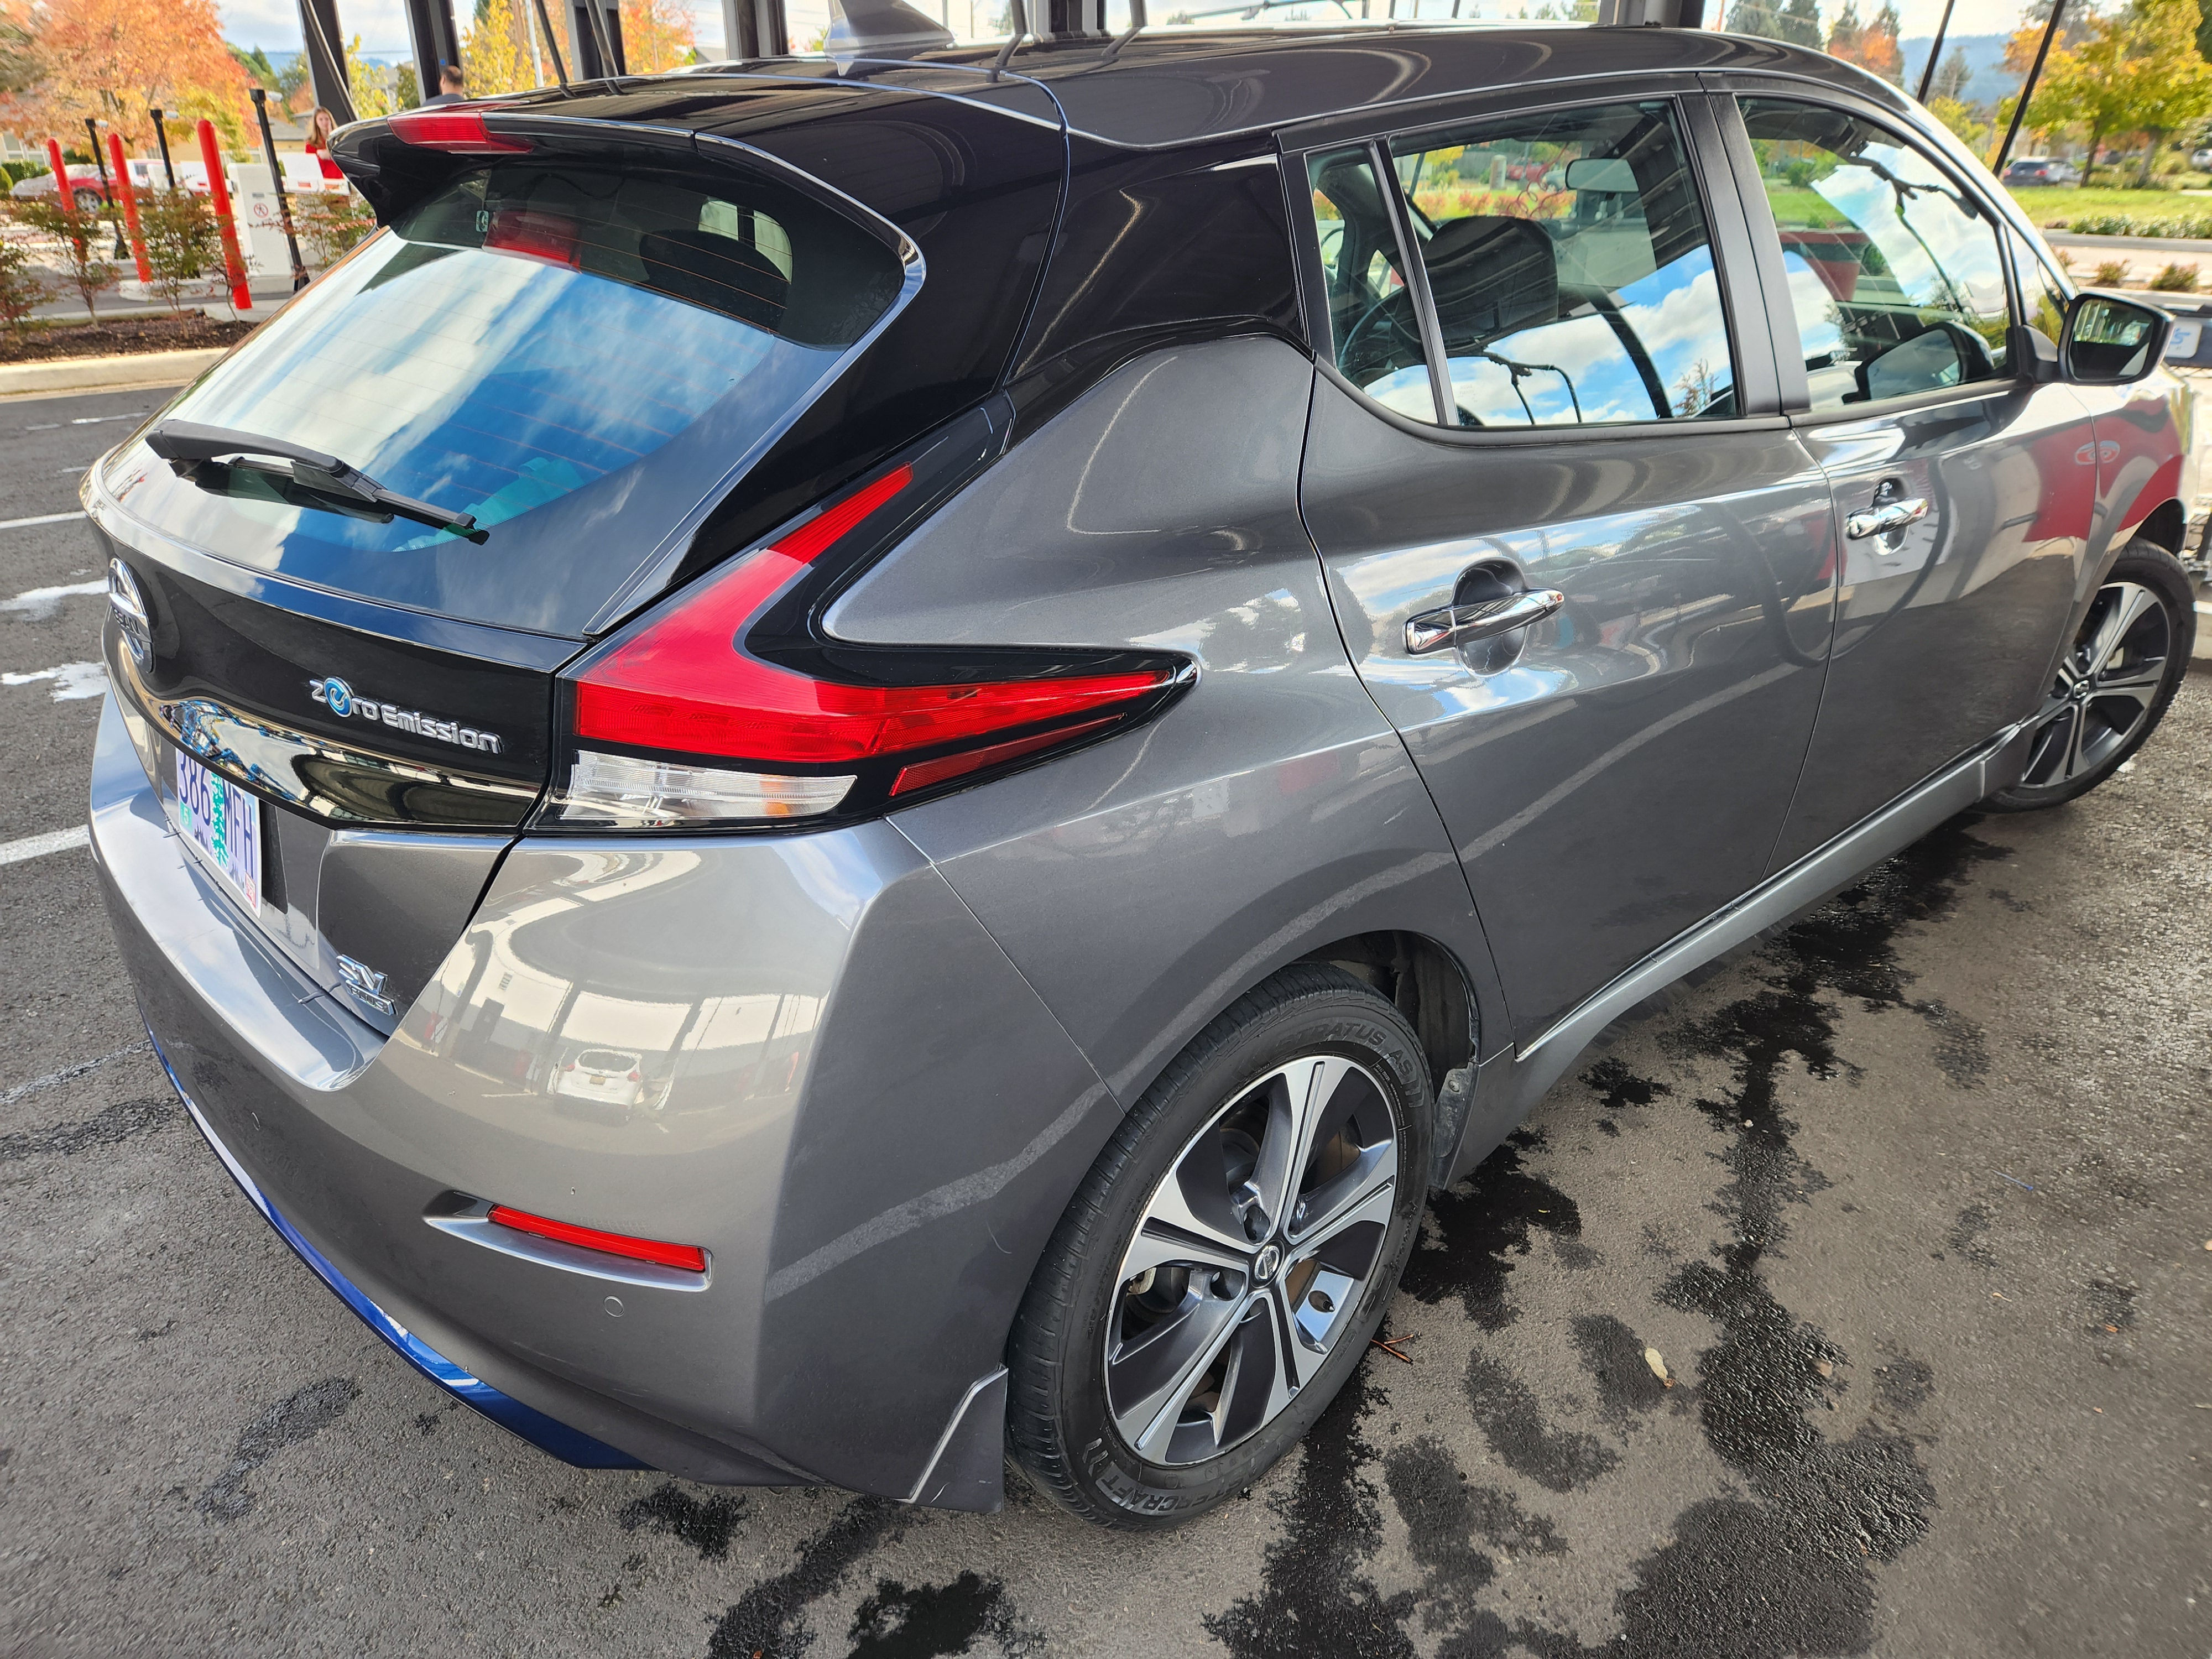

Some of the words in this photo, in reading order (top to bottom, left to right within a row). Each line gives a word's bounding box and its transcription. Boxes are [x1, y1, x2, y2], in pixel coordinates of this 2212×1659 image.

[112, 607, 140, 635] SSAN
[179, 753, 211, 826] 386
[336, 955, 387, 995] SV
[348, 982, 388, 1013] PLUS
[1389, 1049, 1413, 1076] AS
